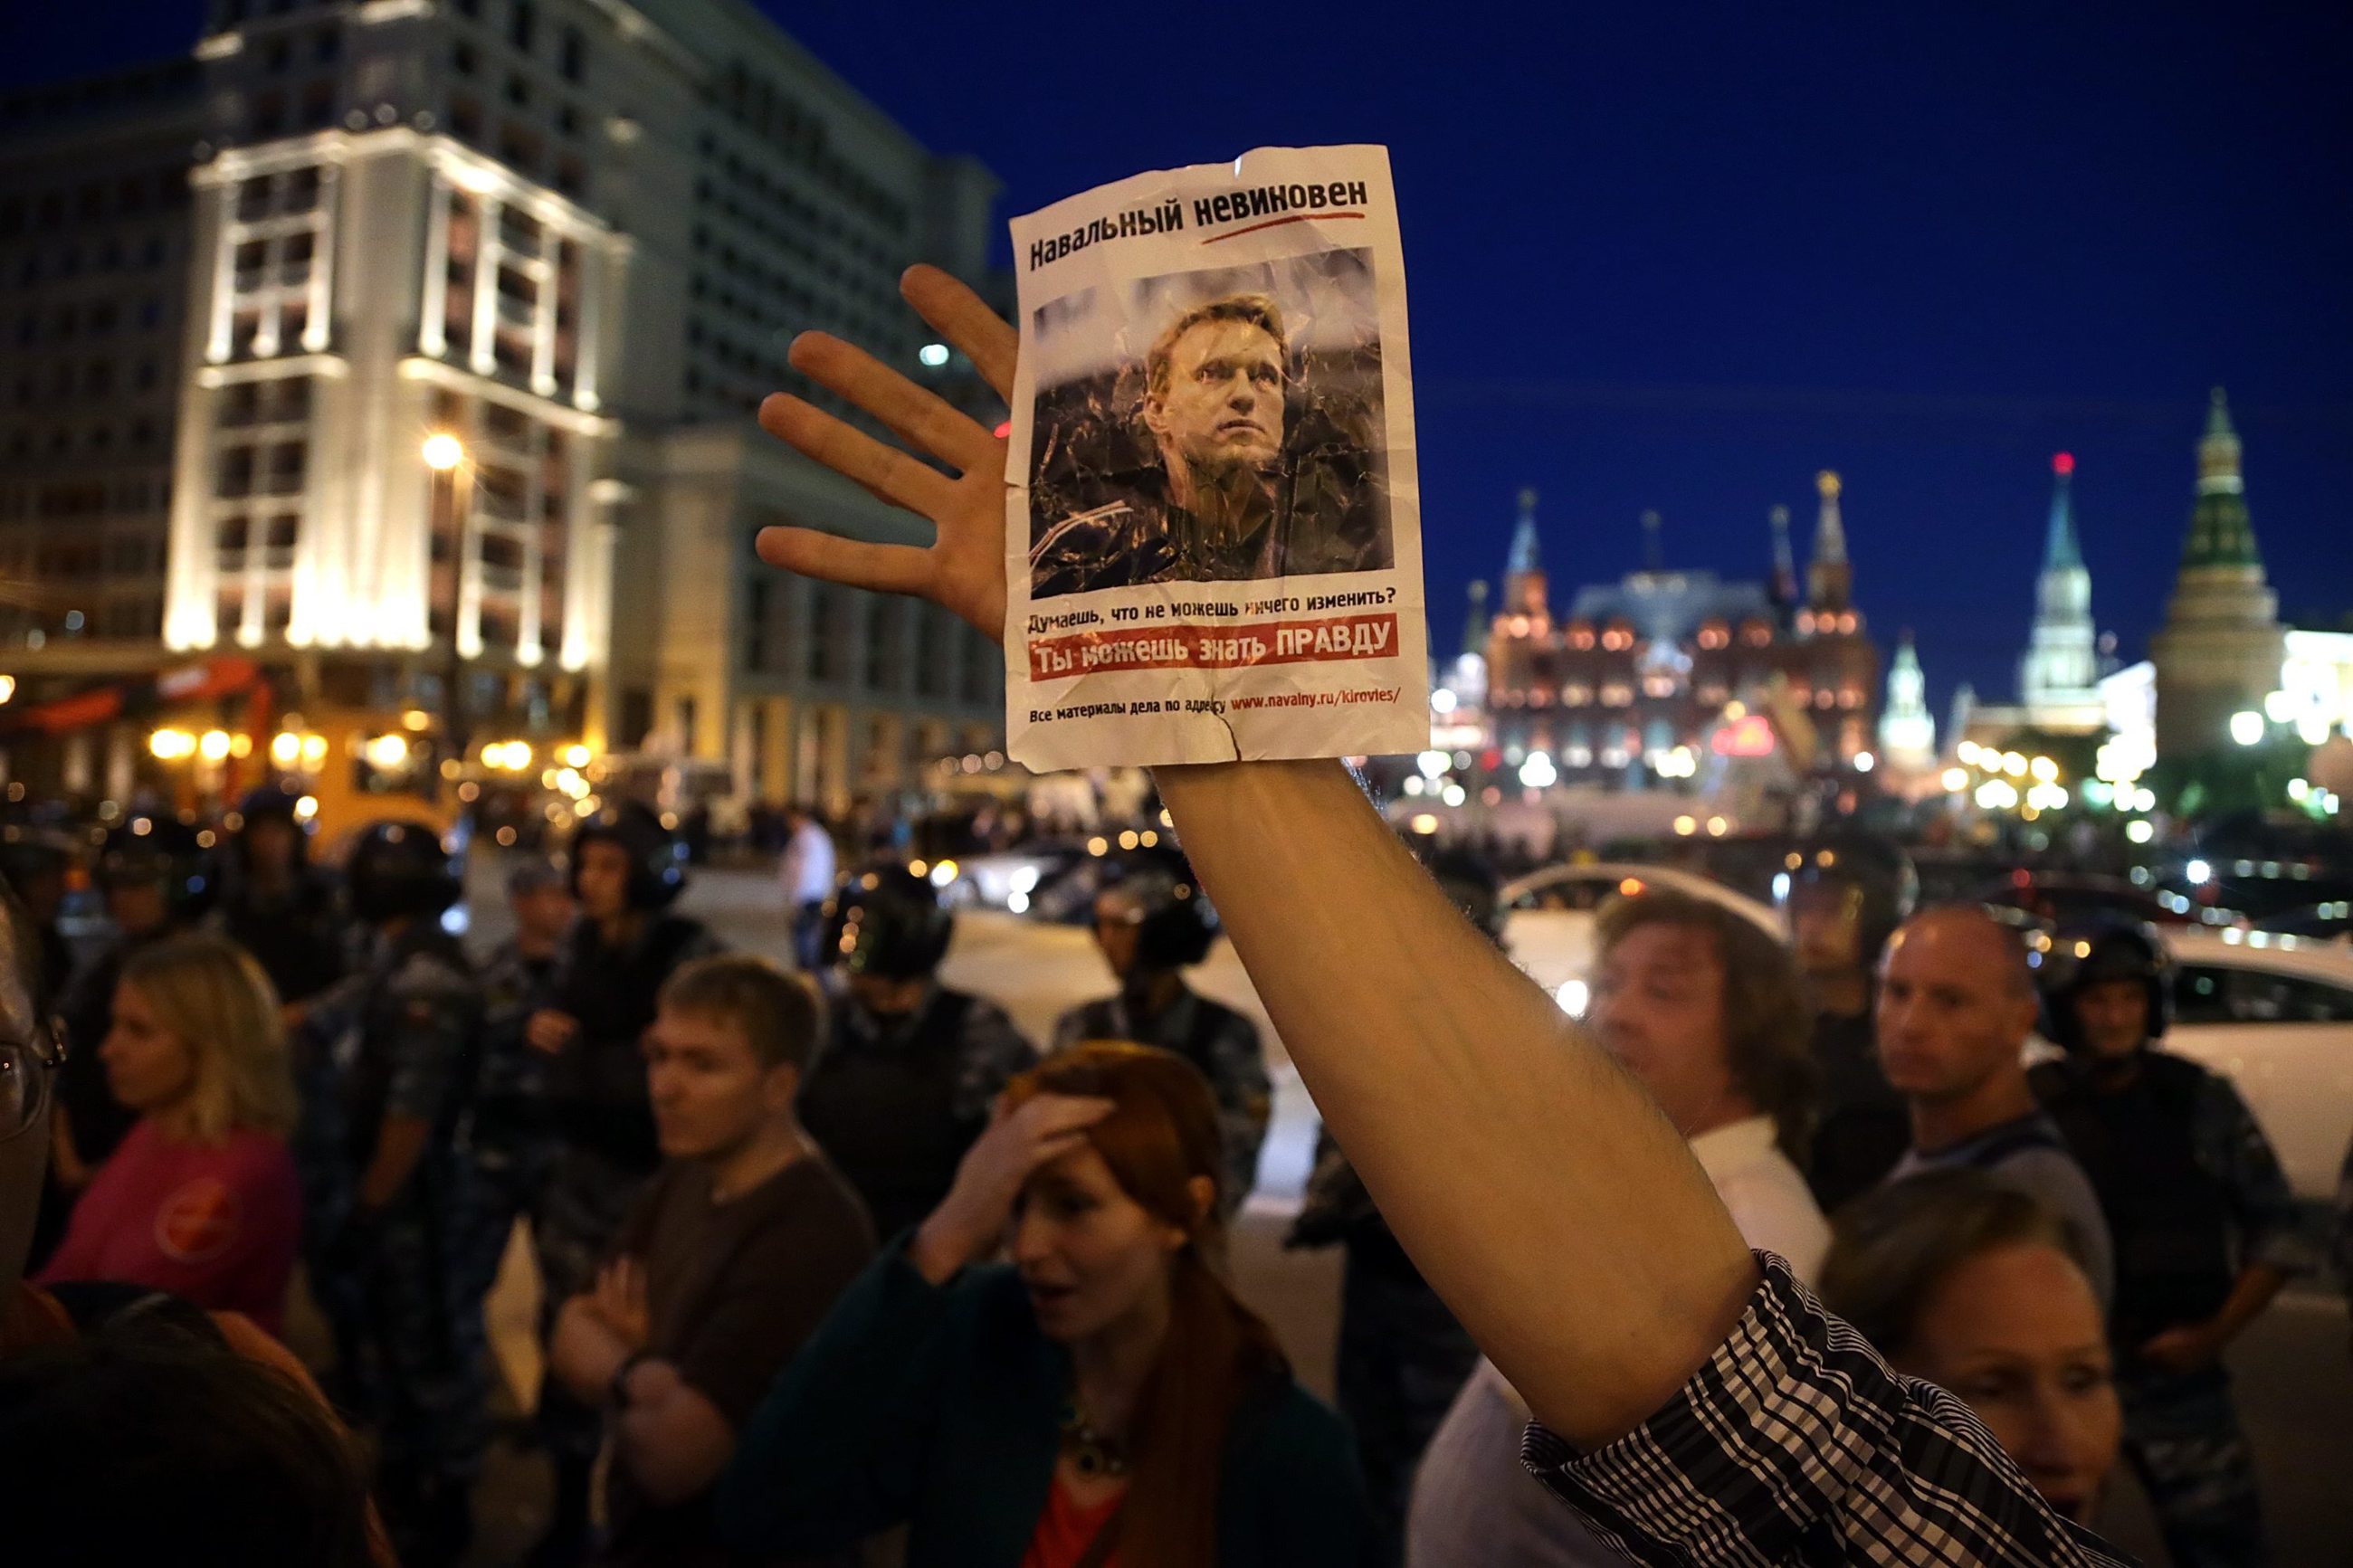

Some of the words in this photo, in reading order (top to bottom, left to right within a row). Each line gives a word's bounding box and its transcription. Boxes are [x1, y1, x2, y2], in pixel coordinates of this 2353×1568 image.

[1030, 199, 1183, 271] Навальный
[1194, 181, 1367, 226] невиновен
[1028, 610, 1104, 633] Думаешь,
[1111, 607, 1138, 622] что
[1146, 604, 1165, 618] не
[1171, 602, 1238, 617] можешь
[1245, 597, 1300, 615] ничего
[1307, 587, 1396, 611] изменить?
[1035, 646, 1072, 673] Ты
[1082, 639, 1188, 667] можешь
[1199, 636, 1266, 661] знать
[1276, 622, 1391, 656] ПРАВДУ
[1030, 709, 1052, 723] Все
[1057, 700, 1126, 718] материалы
[1131, 700, 1160, 715] дела
[1166, 698, 1180, 711] по
[1186, 699, 1225, 714] адресу
